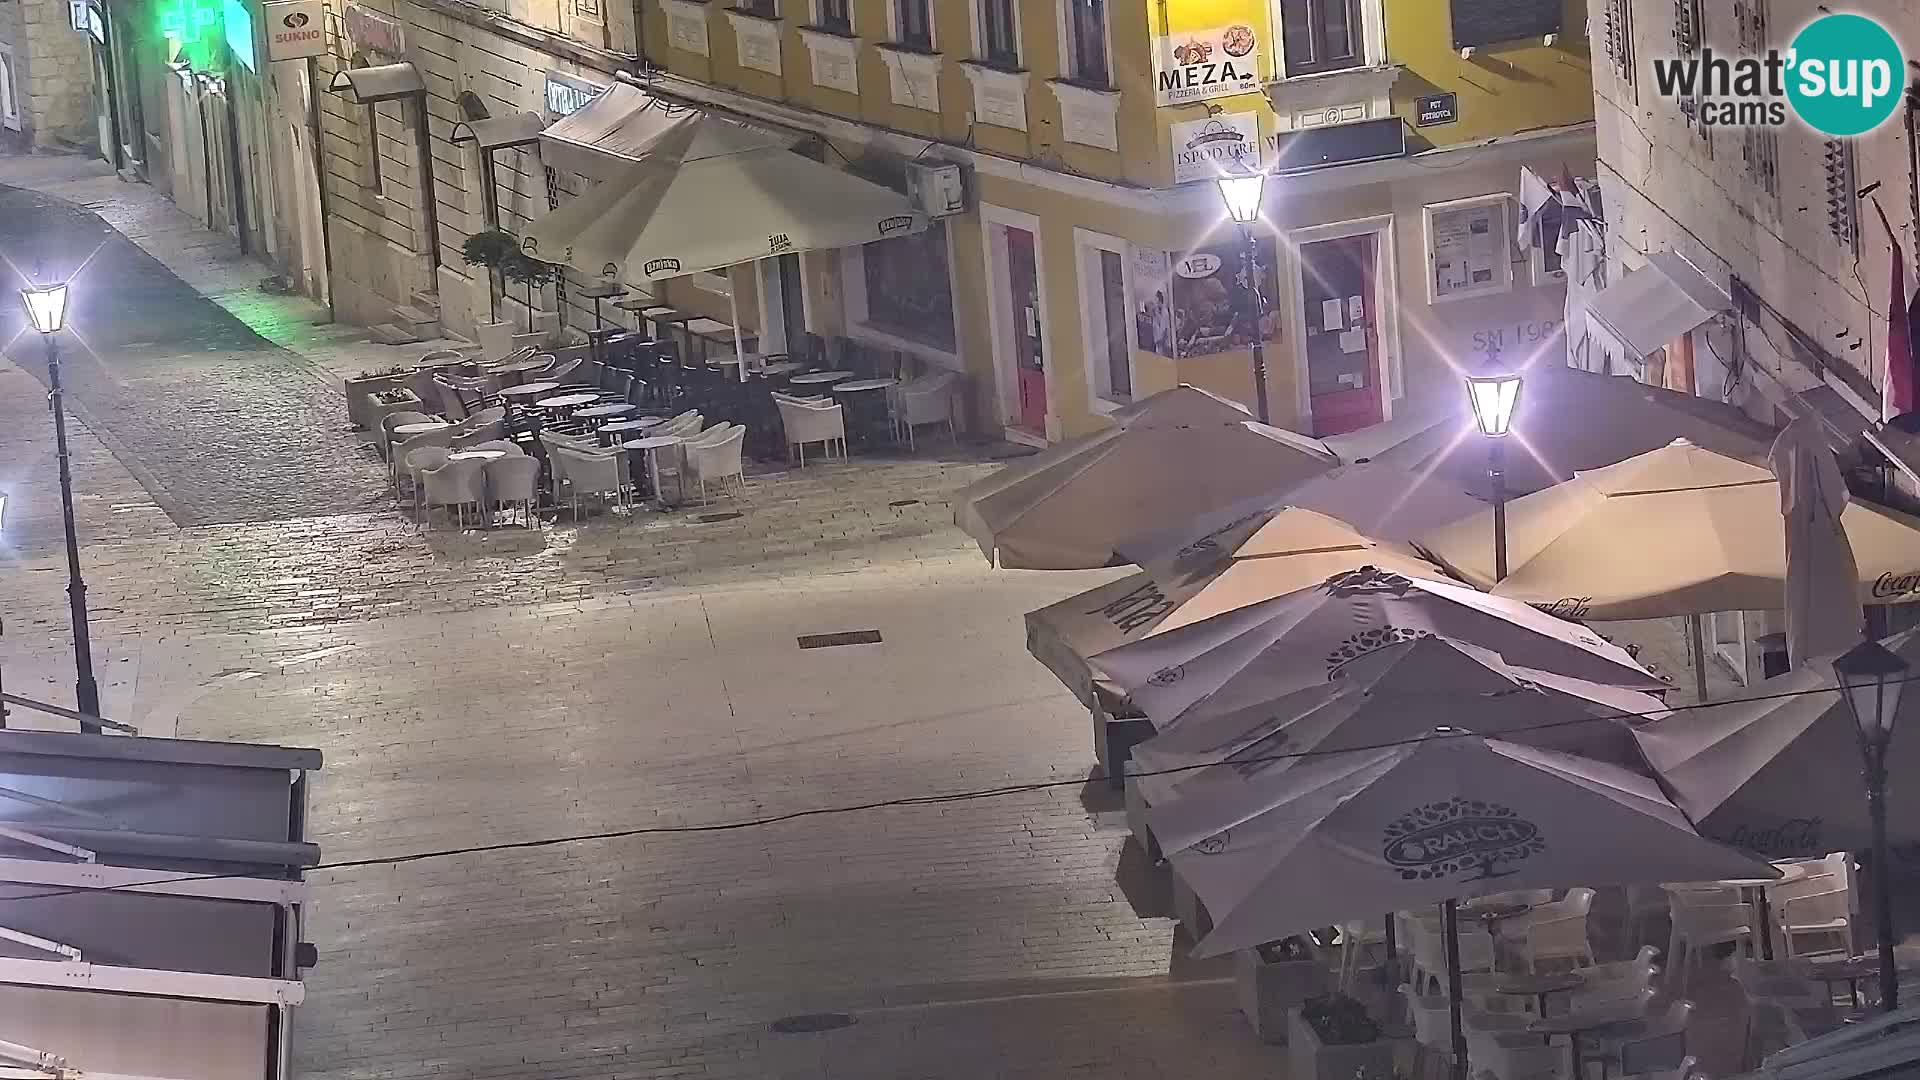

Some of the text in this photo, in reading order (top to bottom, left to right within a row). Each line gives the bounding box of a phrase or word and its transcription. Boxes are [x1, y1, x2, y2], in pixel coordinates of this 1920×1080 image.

[275, 29, 320, 43] SUKNO
[1159, 61, 1238, 91] MEZA
[1168, 87, 1201, 99] PIZZERIA
[1208, 83, 1229, 94] GRILL
[1177, 147, 1223, 165] ISPOD
[1424, 822, 1520, 858] RAUCH
